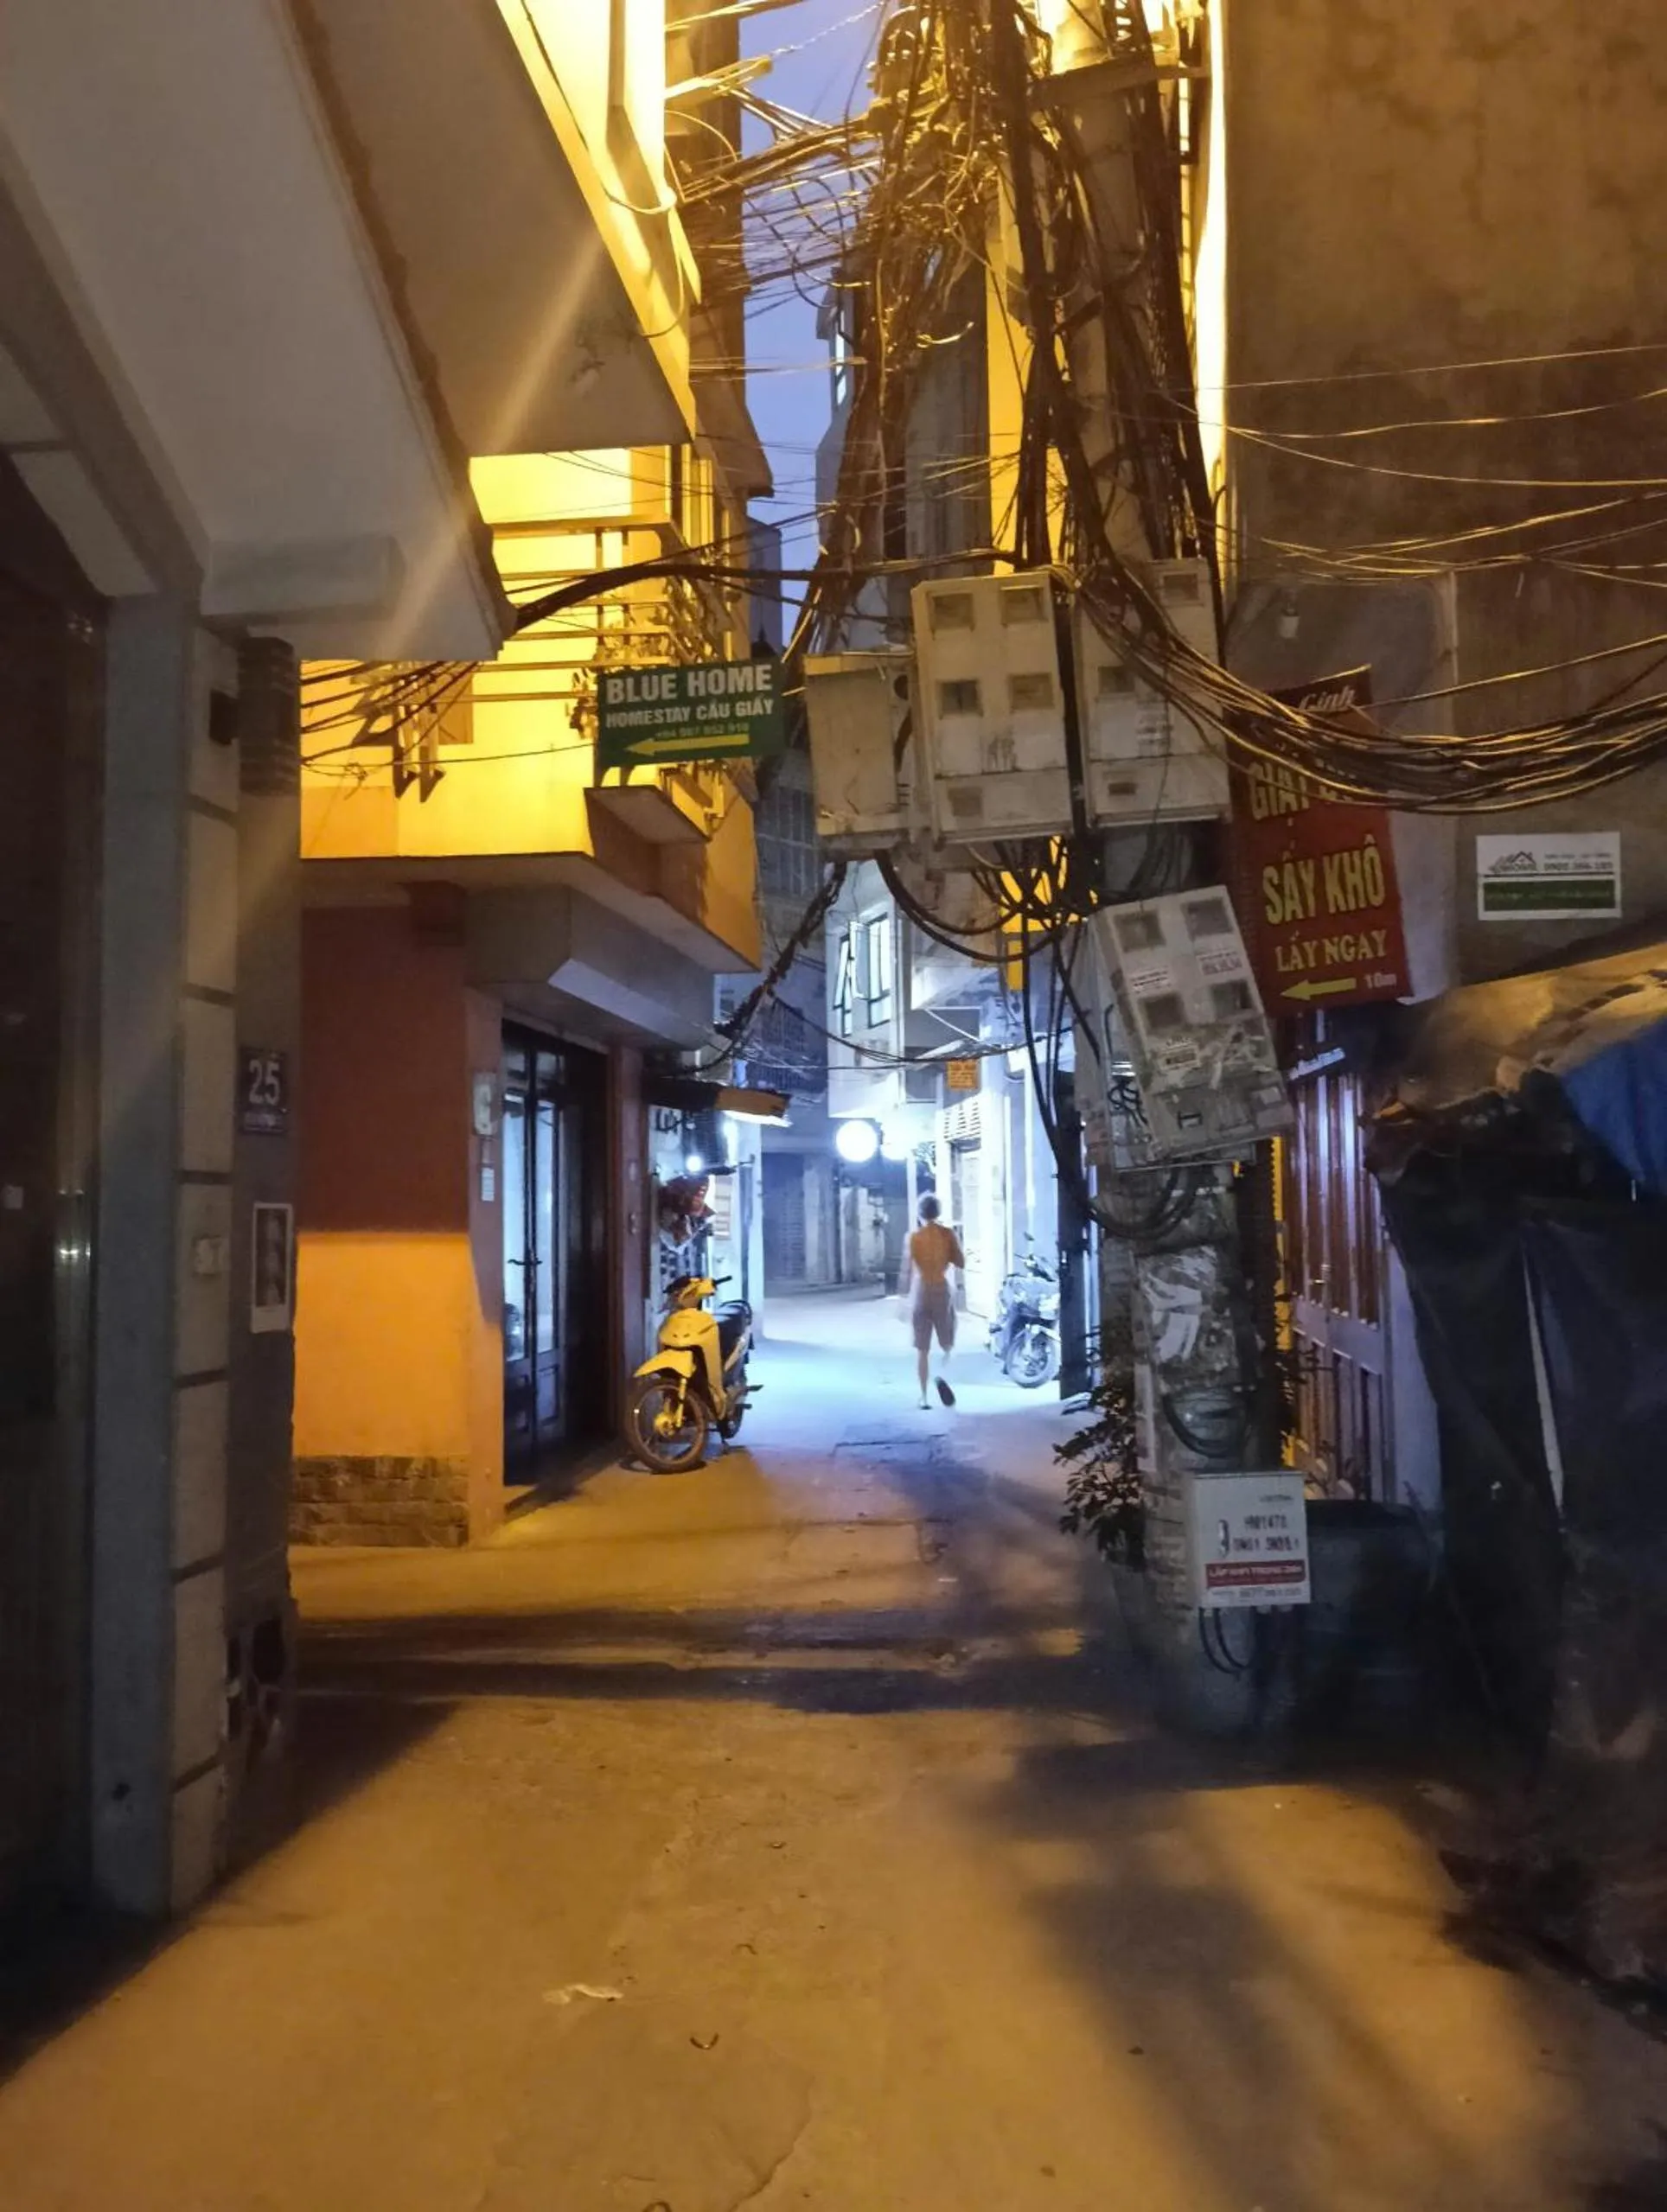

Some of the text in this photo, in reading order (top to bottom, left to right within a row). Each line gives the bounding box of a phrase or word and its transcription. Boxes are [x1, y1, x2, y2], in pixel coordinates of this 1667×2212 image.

[606, 664, 773, 705] BLUE HOME
[606, 705, 691, 729] HOMESTAY
[1262, 833, 1386, 925] SẤY KHÔ
[1275, 929, 1318, 972] LẤY
[1322, 928, 1387, 965] NGAY
[249, 1059, 280, 1106] 25
